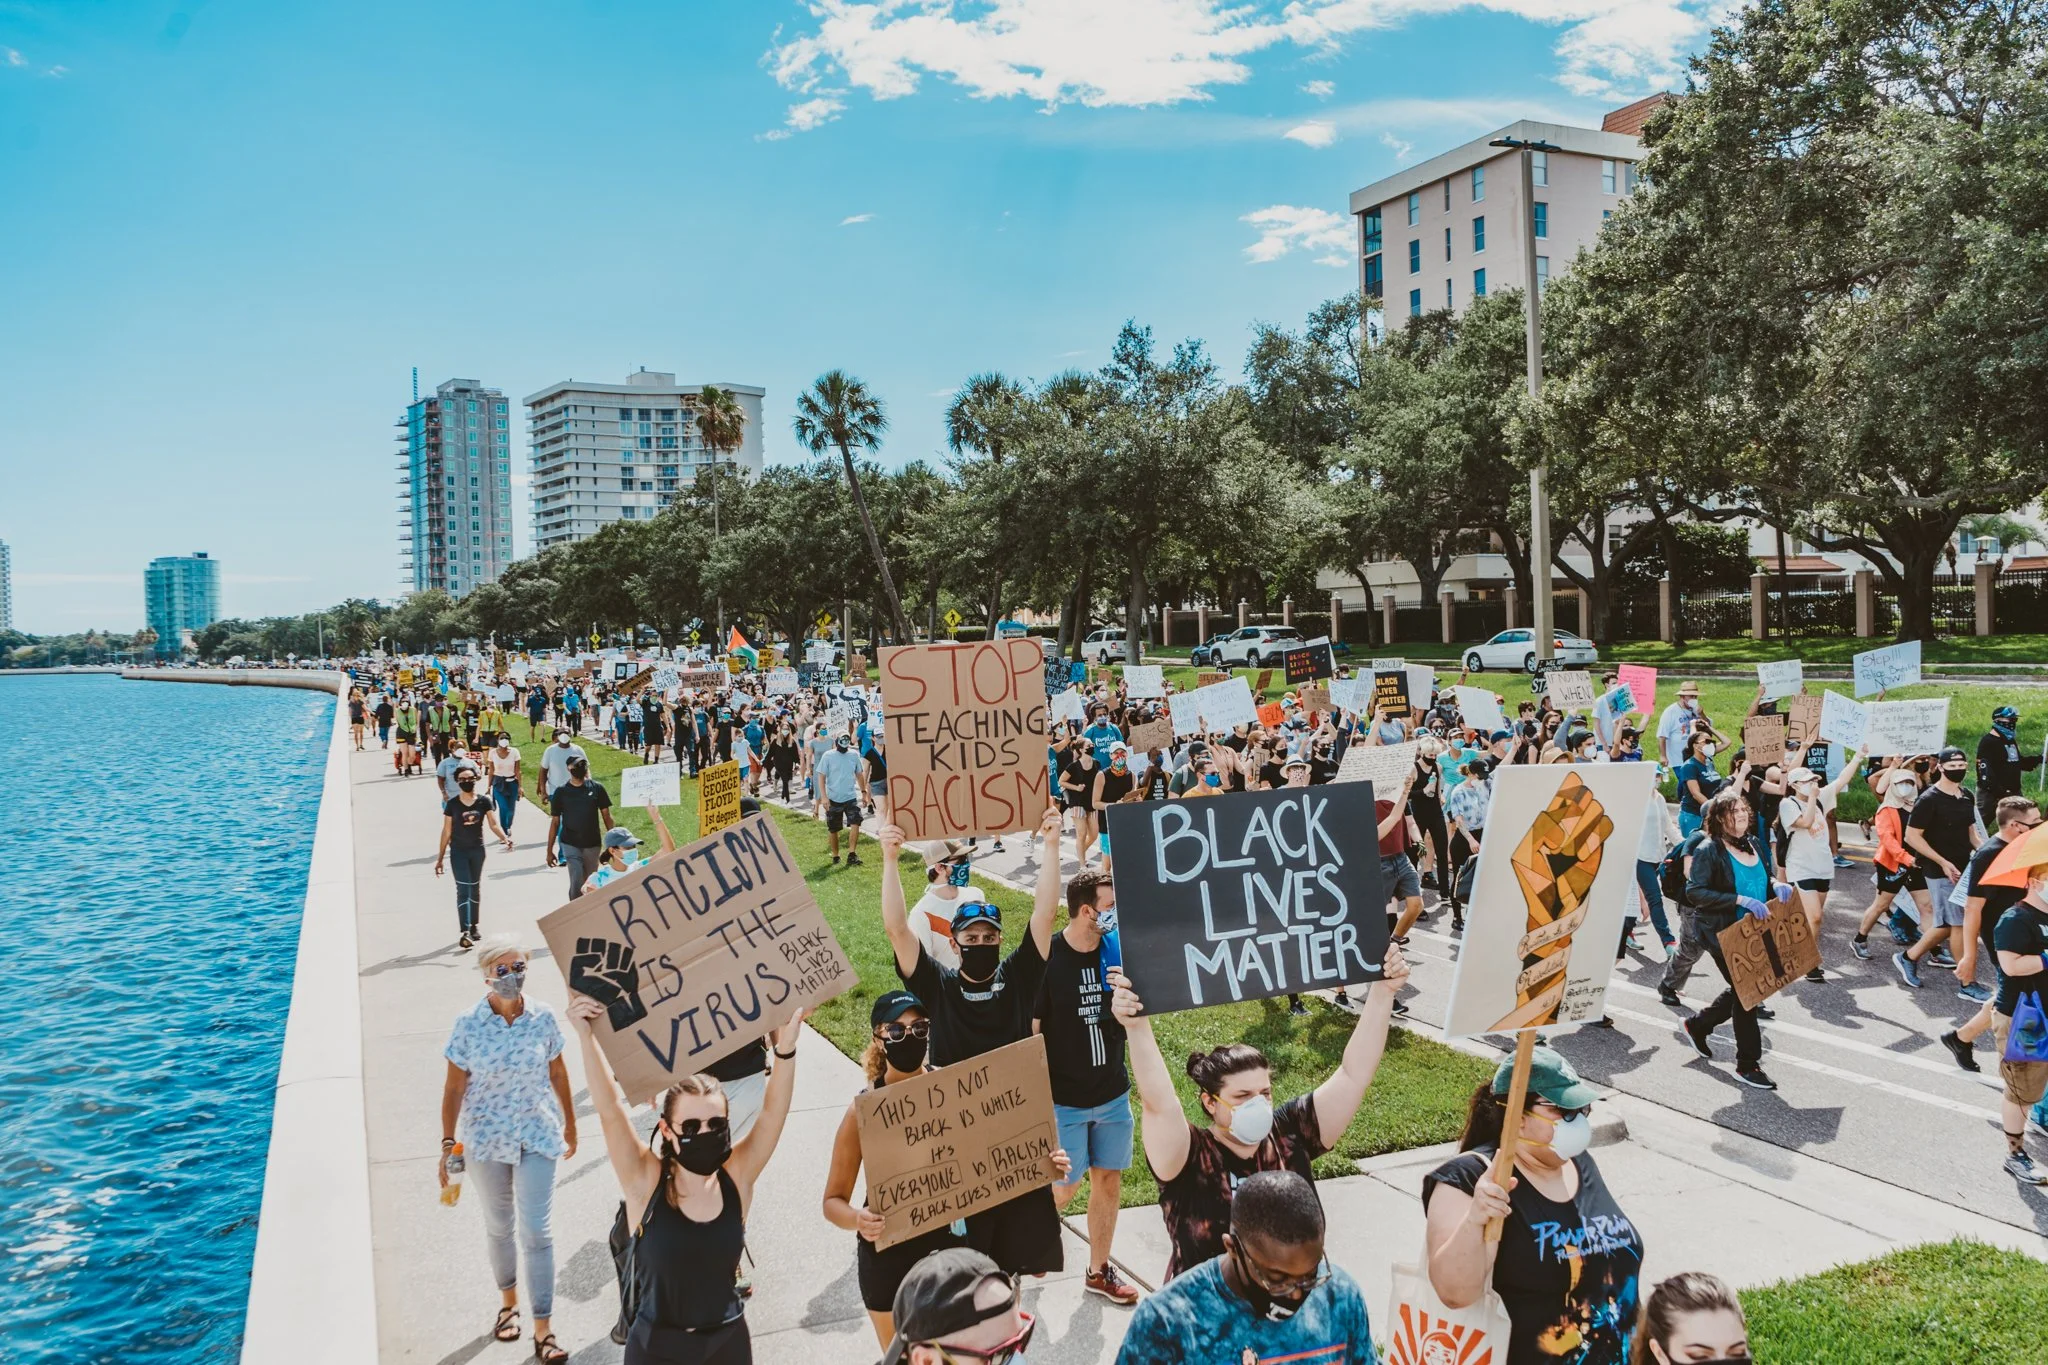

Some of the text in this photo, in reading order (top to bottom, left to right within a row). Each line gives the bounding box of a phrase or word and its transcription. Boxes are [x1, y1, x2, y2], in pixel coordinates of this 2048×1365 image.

[1288, 651, 1311, 661] BLACK
[1290, 659, 1310, 668] LIVES
[682, 673, 720, 682] NO JUSTICE
[888, 639, 1044, 708] STOP
[1047, 671, 1069, 681] LIVID
[1290, 665, 1317, 676] MATTER
[1547, 673, 1555, 684] IF
[1558, 671, 1574, 683] NOT
[1860, 668, 1885, 680] Police
[1376, 677, 1398, 686] BLACK
[1377, 687, 1398, 695] LIVES
[1379, 696, 1406, 705] MATTER
[1872, 704, 1904, 715] Injustice
[1264, 705, 1282, 723] BLM
[1745, 716, 1782, 730] INJUSTICE
[1806, 708, 1820, 719] IS
[885, 705, 1044, 744] TEACHING
[1870, 723, 1897, 733] Justice
[930, 738, 1020, 771] KIDS
[1750, 743, 1781, 755] JUSTICE
[703, 767, 728, 786] Justice
[703, 776, 738, 798] GEORGE
[705, 792, 736, 811] FLOYD:
[890, 764, 1050, 837] RACISM
[716, 809, 738, 825] degree
[1152, 794, 1344, 884] BLACK
[608, 817, 790, 949] RACISM
[1200, 862, 1348, 941] LIVES
[639, 898, 796, 1008] IS THE
[779, 926, 828, 964] BLACK
[796, 946, 834, 975] LIVES
[1183, 923, 1381, 1005] MATTER
[793, 960, 846, 996] MATTER
[1079, 983, 1102, 994] BLACK
[1081, 994, 1102, 1005] LIVES
[637, 962, 791, 1073] VIRUS
[873, 1065, 989, 1129] THIS IS NOT
[905, 1118, 952, 1146] BLACK
[981, 1086, 1026, 1117] WHITE
[878, 1166, 961, 1212] EVERYONE
[991, 1137, 1051, 1172] RACISM
[910, 1199, 953, 1227] BLACK
[955, 1186, 991, 1209] LIVES
[1530, 1215, 1599, 1262] Purple
[1590, 1213, 1638, 1246] Rain
